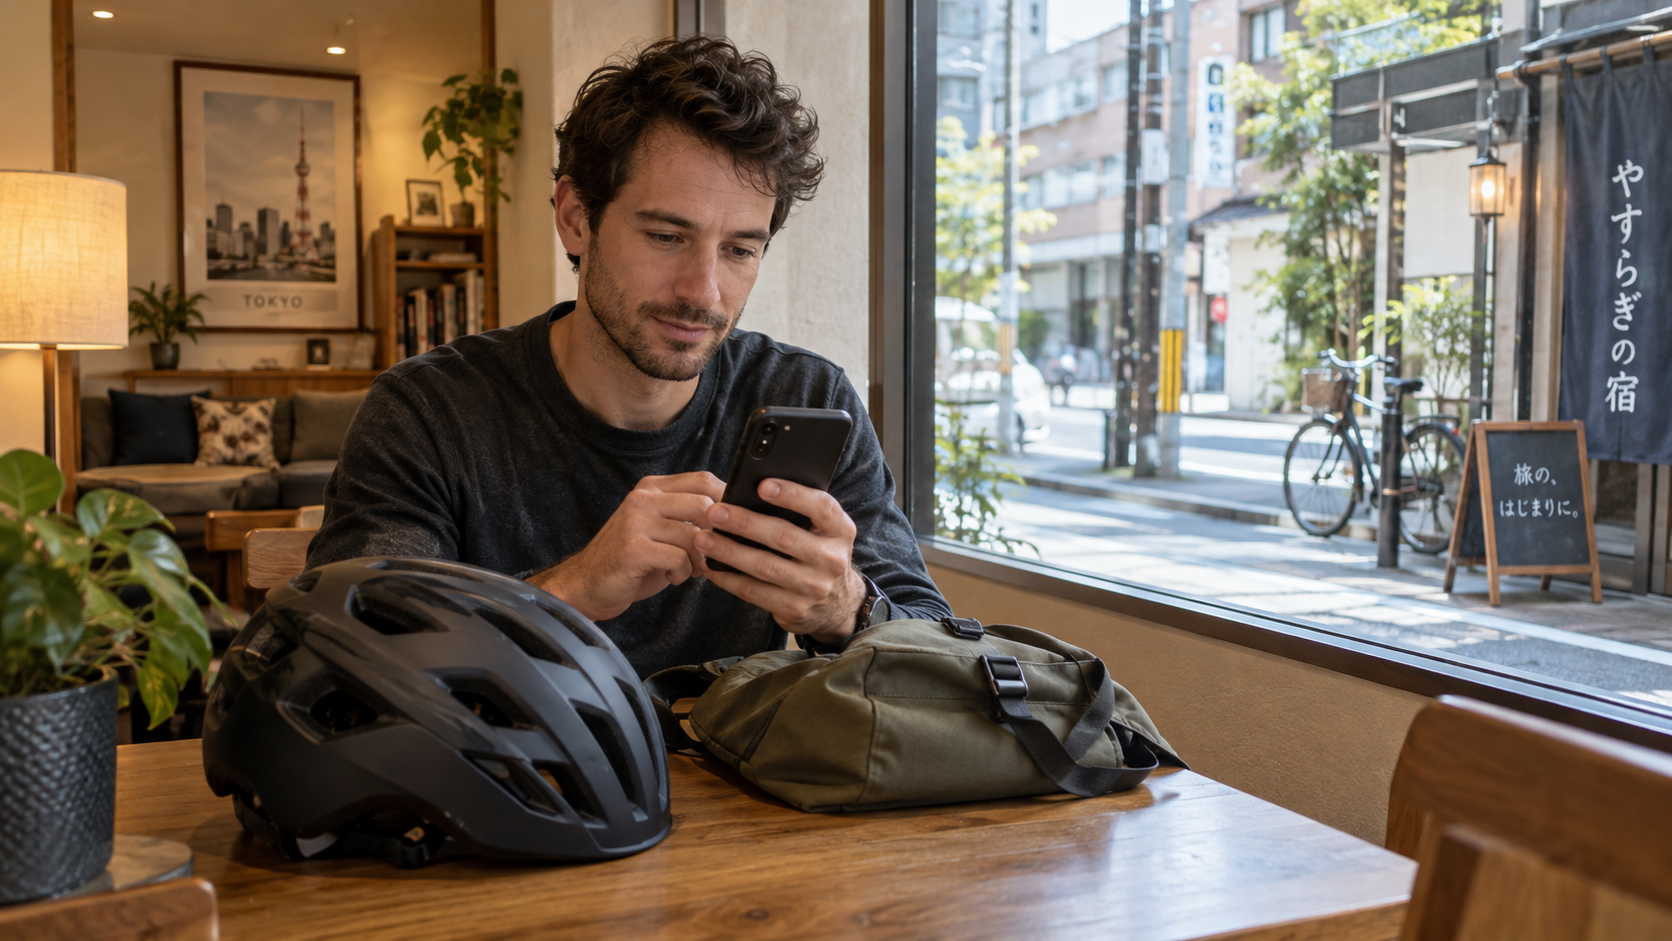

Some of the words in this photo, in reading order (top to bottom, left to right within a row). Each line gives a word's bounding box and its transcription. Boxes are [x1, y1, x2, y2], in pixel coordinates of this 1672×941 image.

[1605, 159, 1644, 413] やすらぎの宿
[243, 294, 303, 309] TOKYO
[1513, 462, 1557, 486] 旅の、
[1500, 498, 1579, 518] はじまりに。
